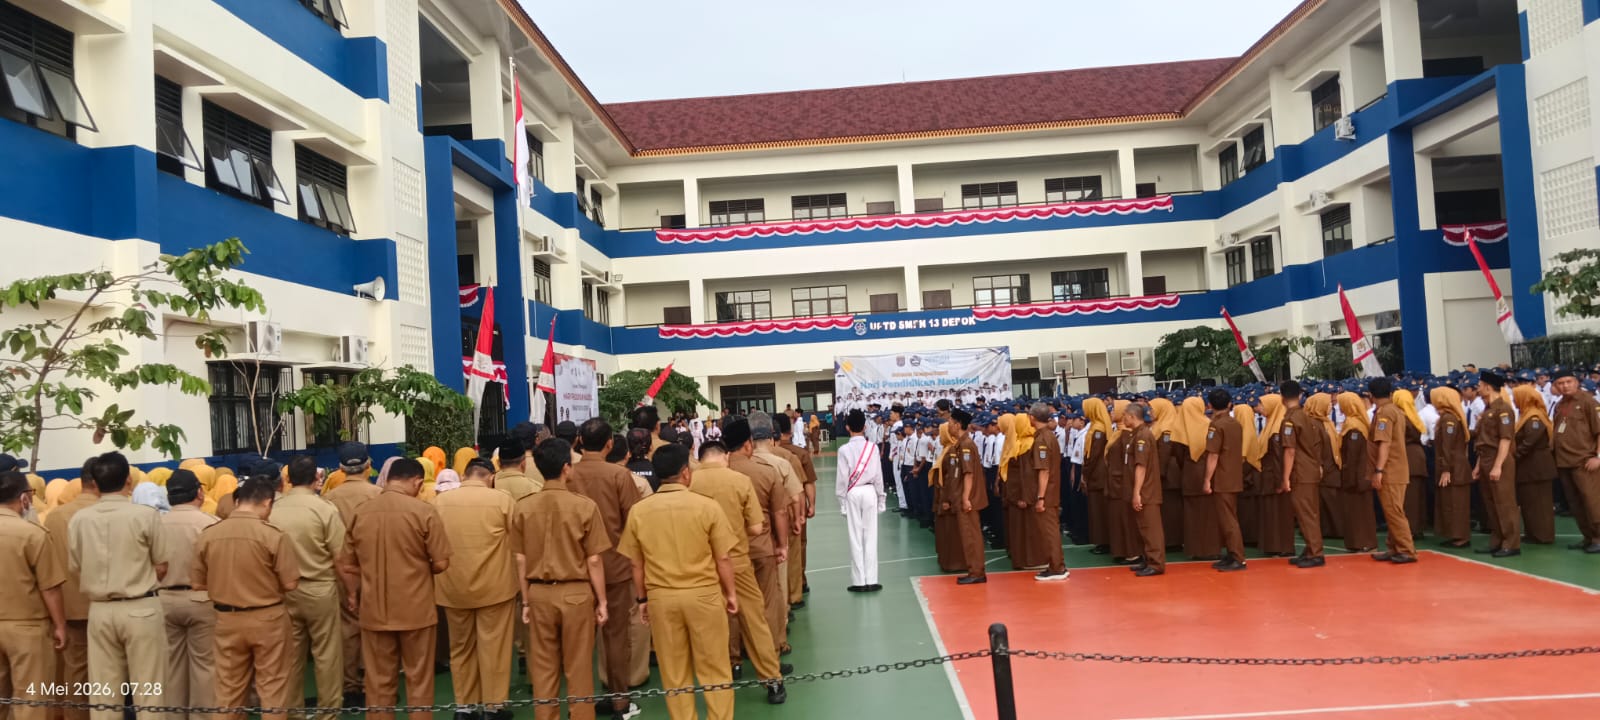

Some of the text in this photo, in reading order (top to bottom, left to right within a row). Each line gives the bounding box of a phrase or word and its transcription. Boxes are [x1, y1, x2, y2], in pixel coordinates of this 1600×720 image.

[929, 318, 939, 328] 13
[882, 378, 935, 388] Pendidikan
[938, 375, 980, 385] Nasional
